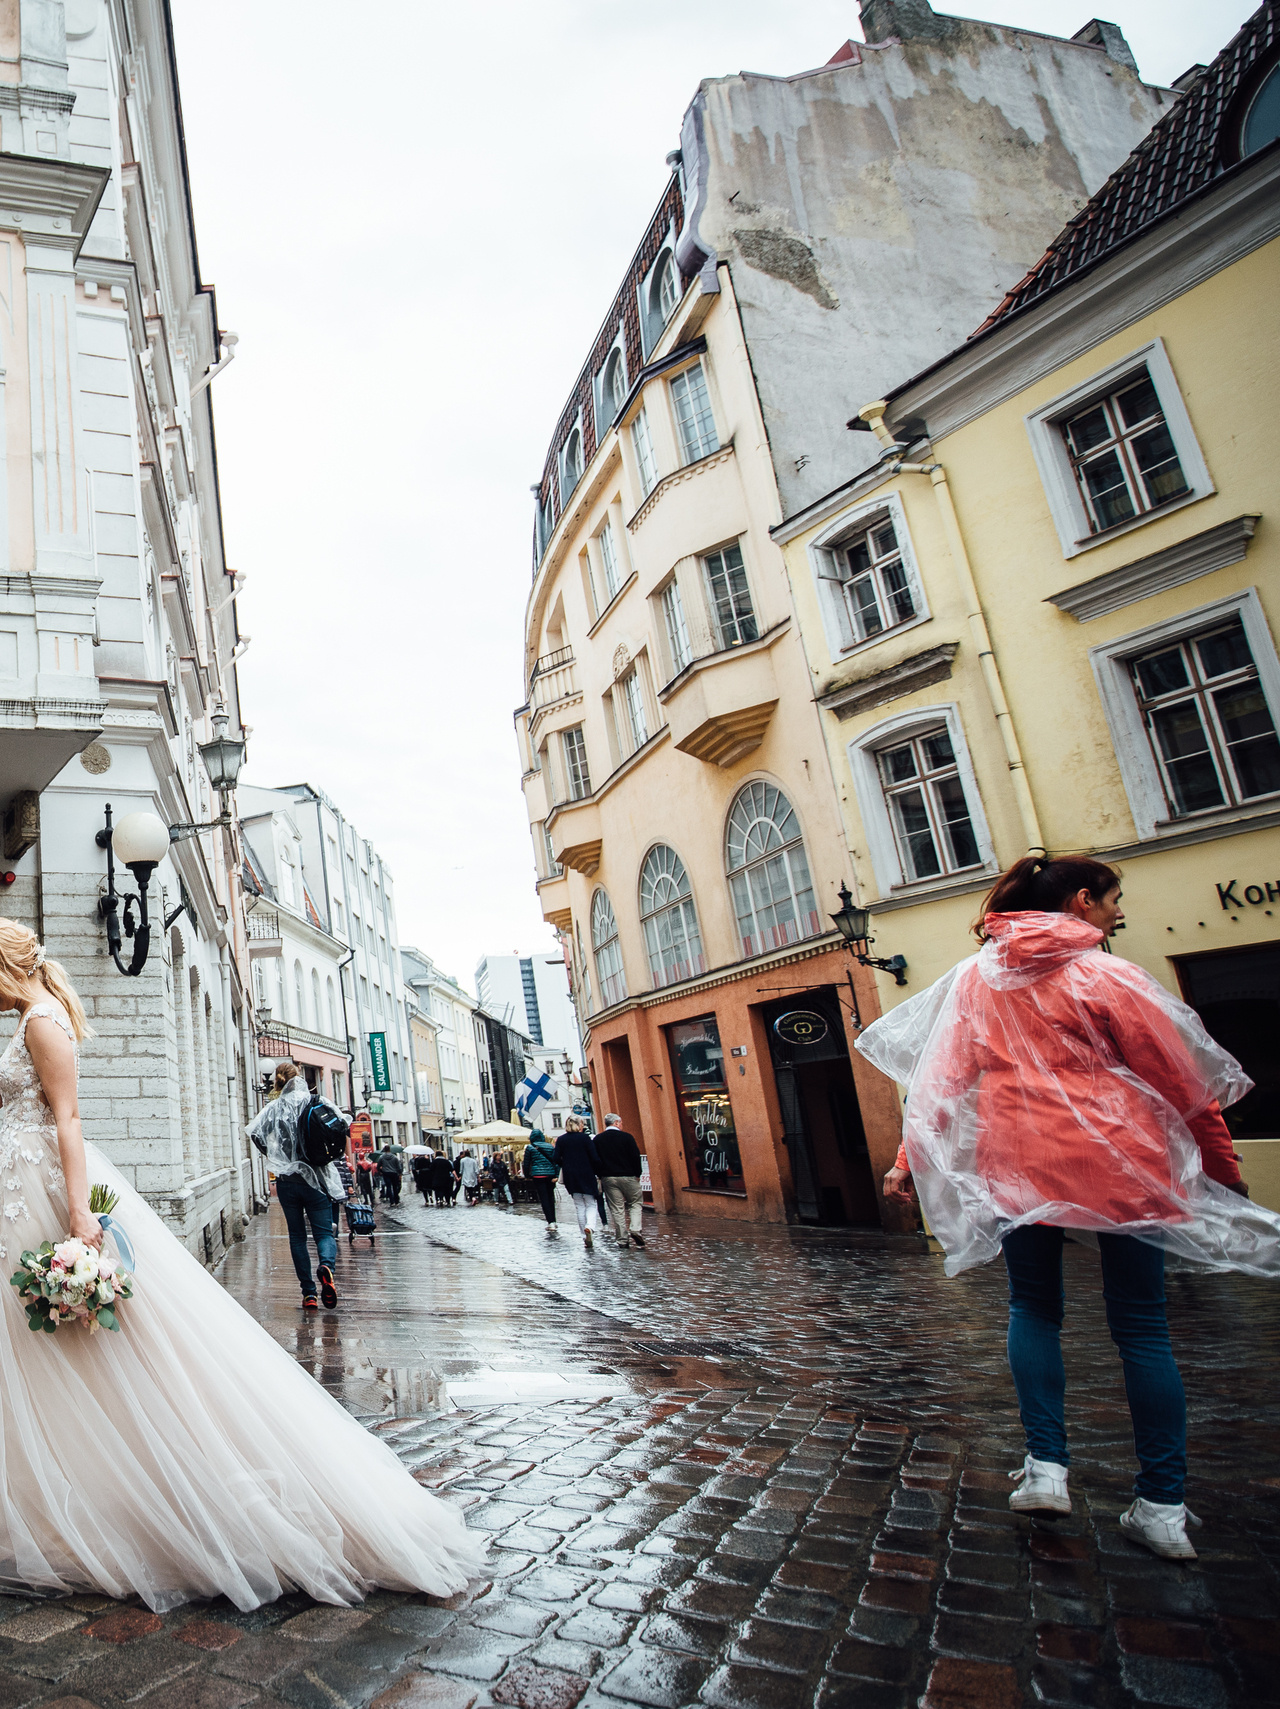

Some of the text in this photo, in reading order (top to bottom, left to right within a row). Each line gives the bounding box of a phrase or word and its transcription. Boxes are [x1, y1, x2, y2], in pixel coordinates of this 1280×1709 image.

[374, 1037, 386, 1086] SALAMANDER
[692, 1103, 728, 1140] Golden
[704, 1149, 729, 1172] Dolls
